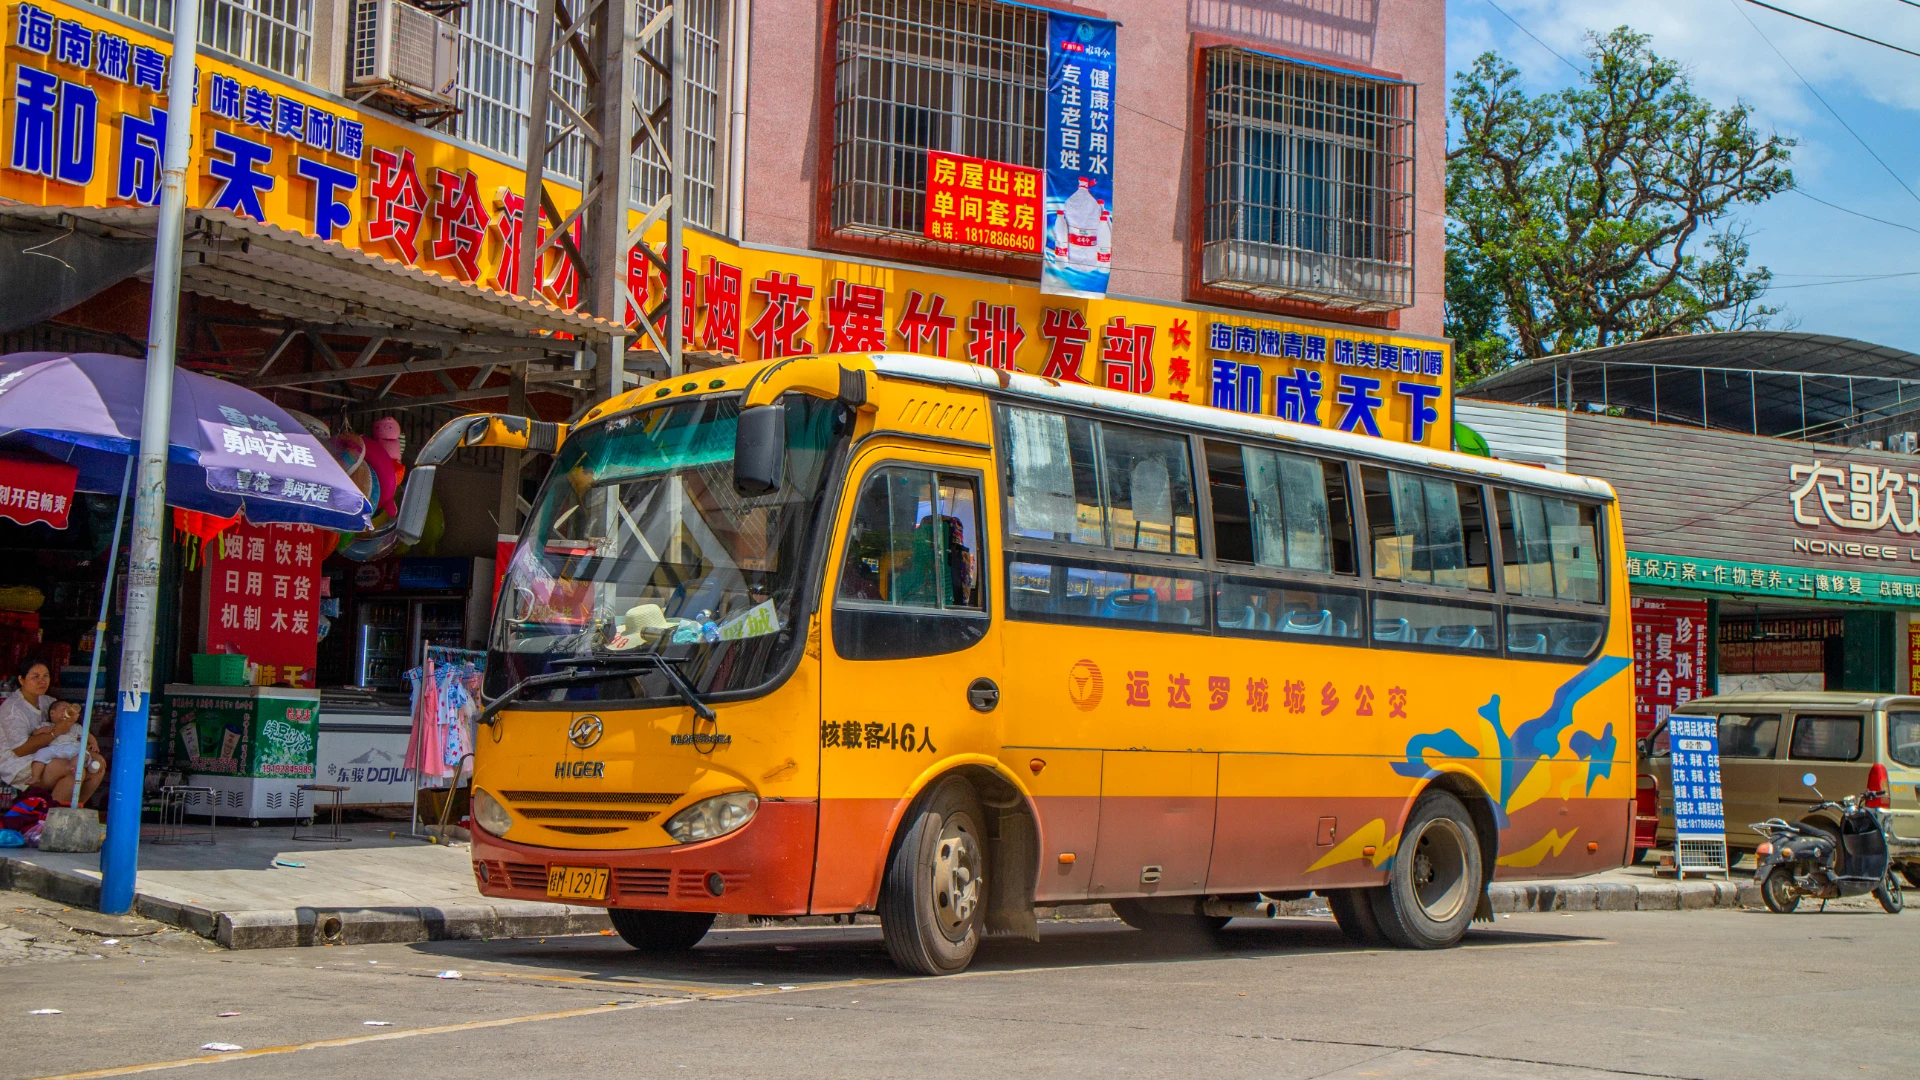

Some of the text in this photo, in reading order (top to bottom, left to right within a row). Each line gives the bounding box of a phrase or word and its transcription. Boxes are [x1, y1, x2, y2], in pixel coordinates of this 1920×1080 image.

[18, 8, 363, 160] 海南嫩青 味美更耐嚼
[1060, 64, 1081, 171] 专注老百姓
[1089, 68, 1110, 175] 健康饮用水
[11, 64, 359, 242] 和成天下
[933, 158, 1037, 198] 房屋出租
[932, 190, 1036, 231] 单间套房
[1209, 323, 1444, 376] 海南嫩青果 味美更耐嚼
[1211, 358, 1443, 443] 和成天下
[222, 427, 317, 468] 勇闯天涯
[281, 477, 332, 503] 勇闯天涯
[224, 532, 313, 568] 烟酒 饮料
[225, 570, 312, 601] 日用 百货
[221, 602, 309, 635] 机制 木炭
[1126, 670, 1408, 719] 运达罗城城乡公交
[1655, 632, 1674, 731] 复合肥
[820, 719, 938, 755] 核载客46人
[337, 767, 365, 783] 东骏
[554, 761, 605, 779] HIGER
